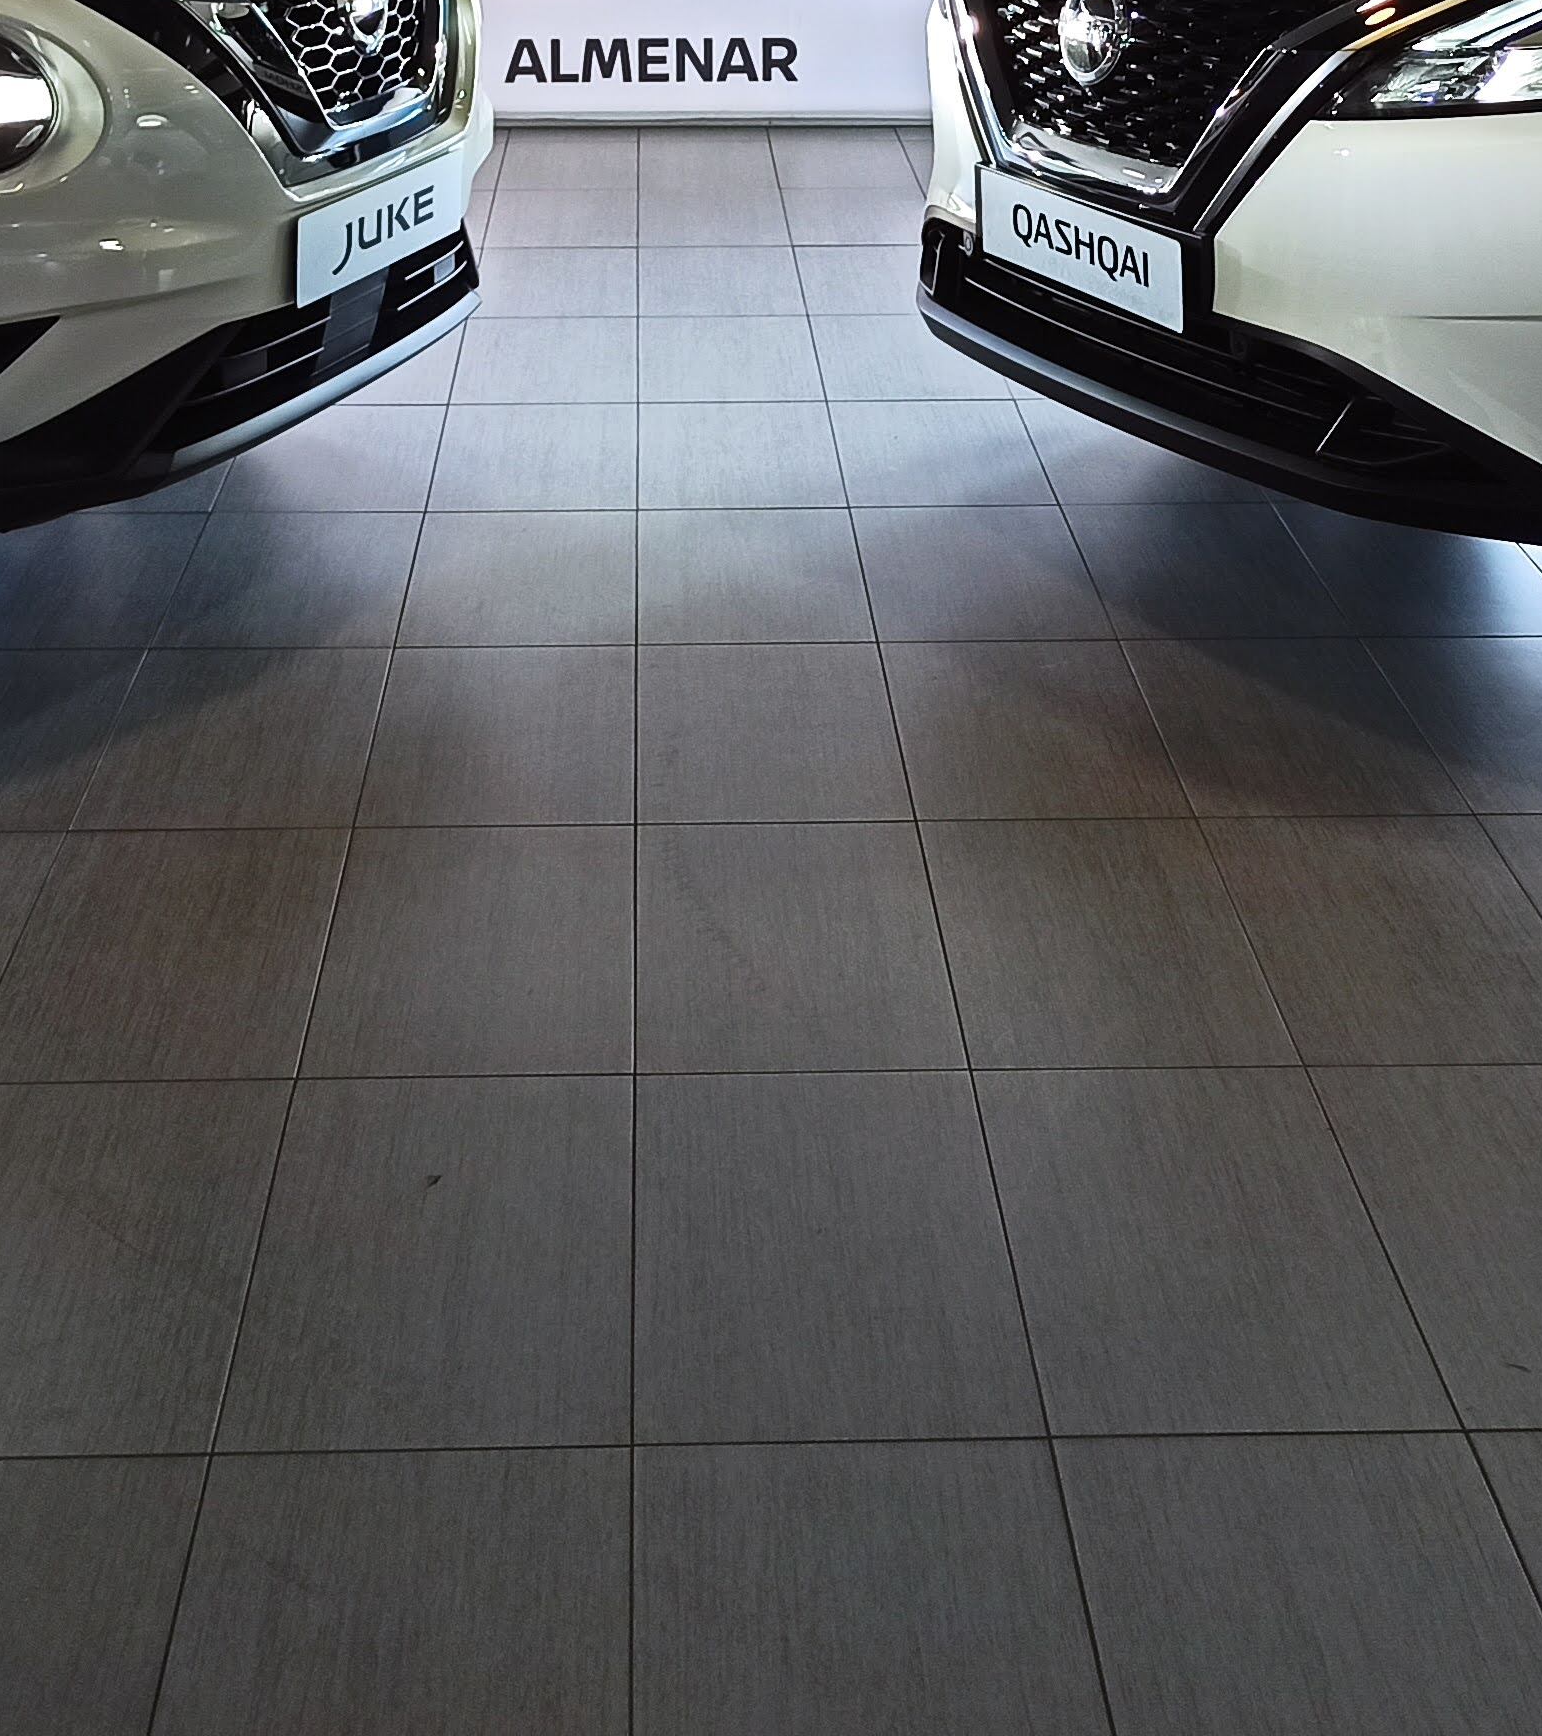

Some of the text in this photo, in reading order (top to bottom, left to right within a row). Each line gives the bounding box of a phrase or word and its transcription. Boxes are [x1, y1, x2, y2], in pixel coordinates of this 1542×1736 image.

[504, 37, 799, 84] ALMENAR
[331, 184, 435, 276] JUKE
[1012, 203, 1150, 288] QASHQAI
